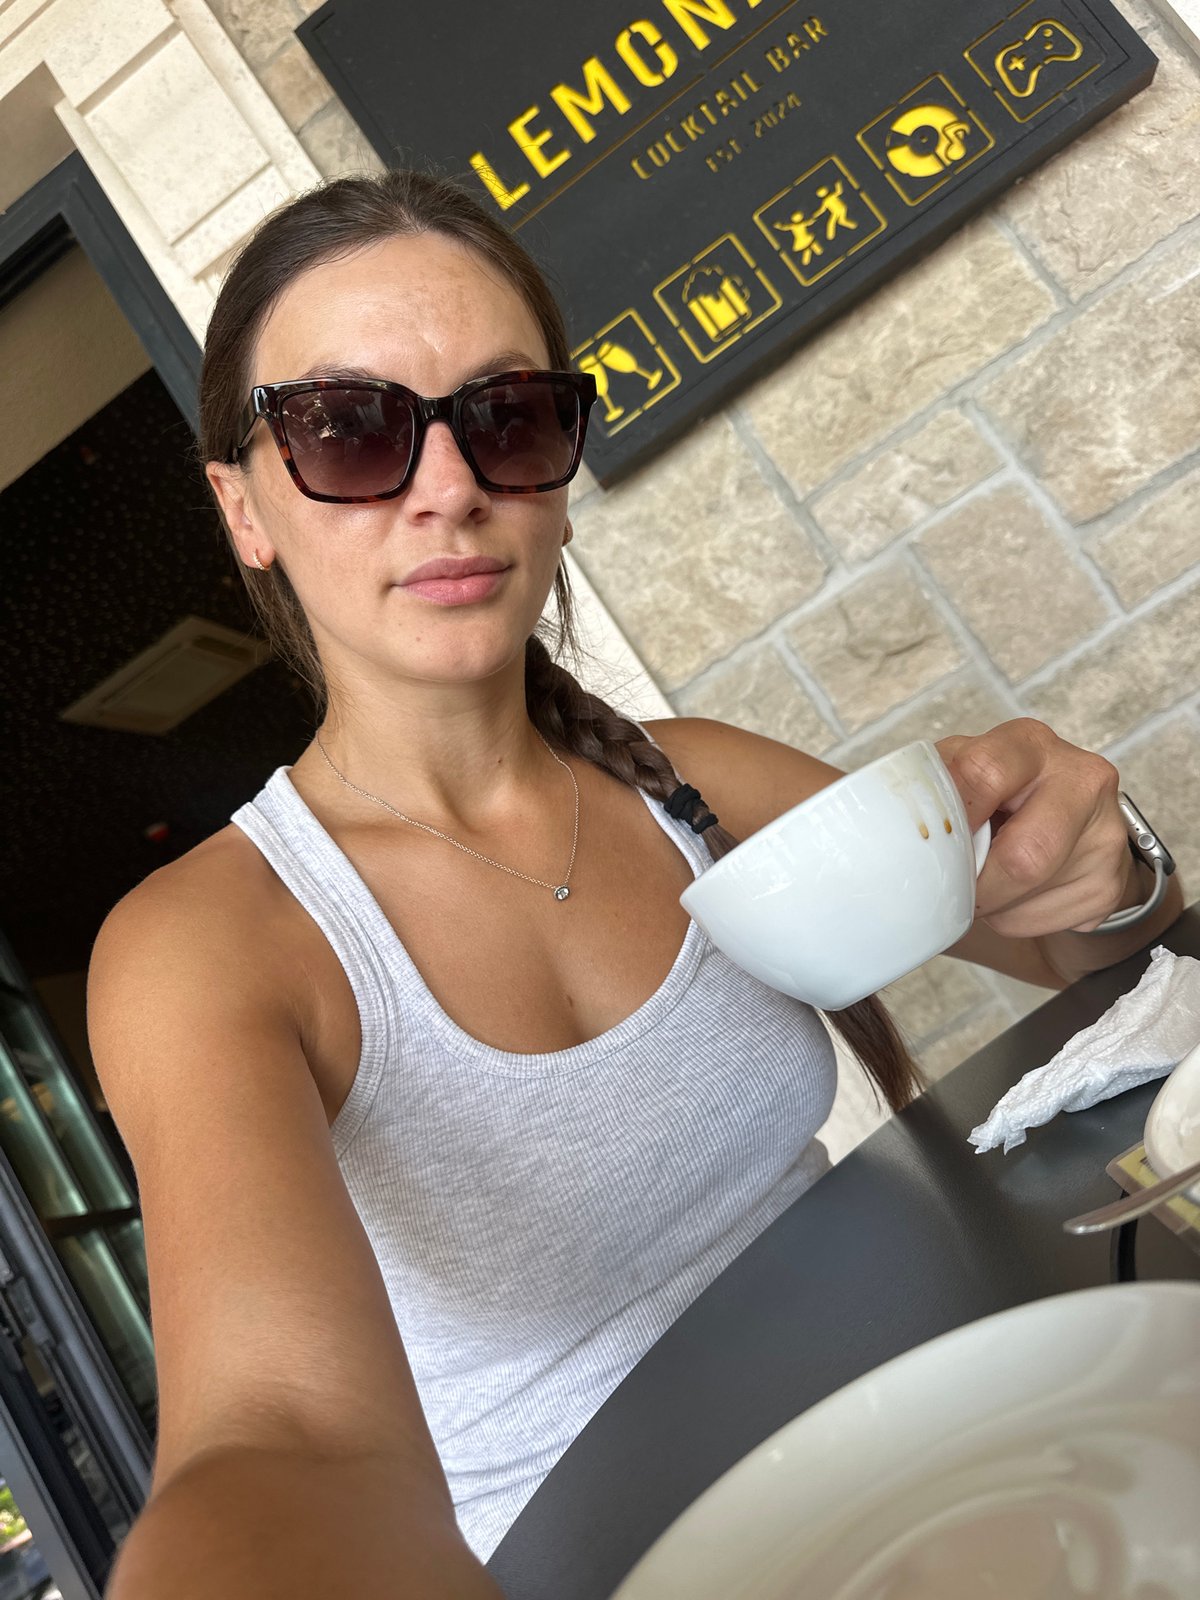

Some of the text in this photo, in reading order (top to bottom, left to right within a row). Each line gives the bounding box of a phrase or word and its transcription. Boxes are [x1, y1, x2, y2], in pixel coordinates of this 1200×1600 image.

[469, 0, 764, 211] LEMON
[630, 16, 830, 181] COCKTAIL BAR
[751, 91, 803, 139] 2024
